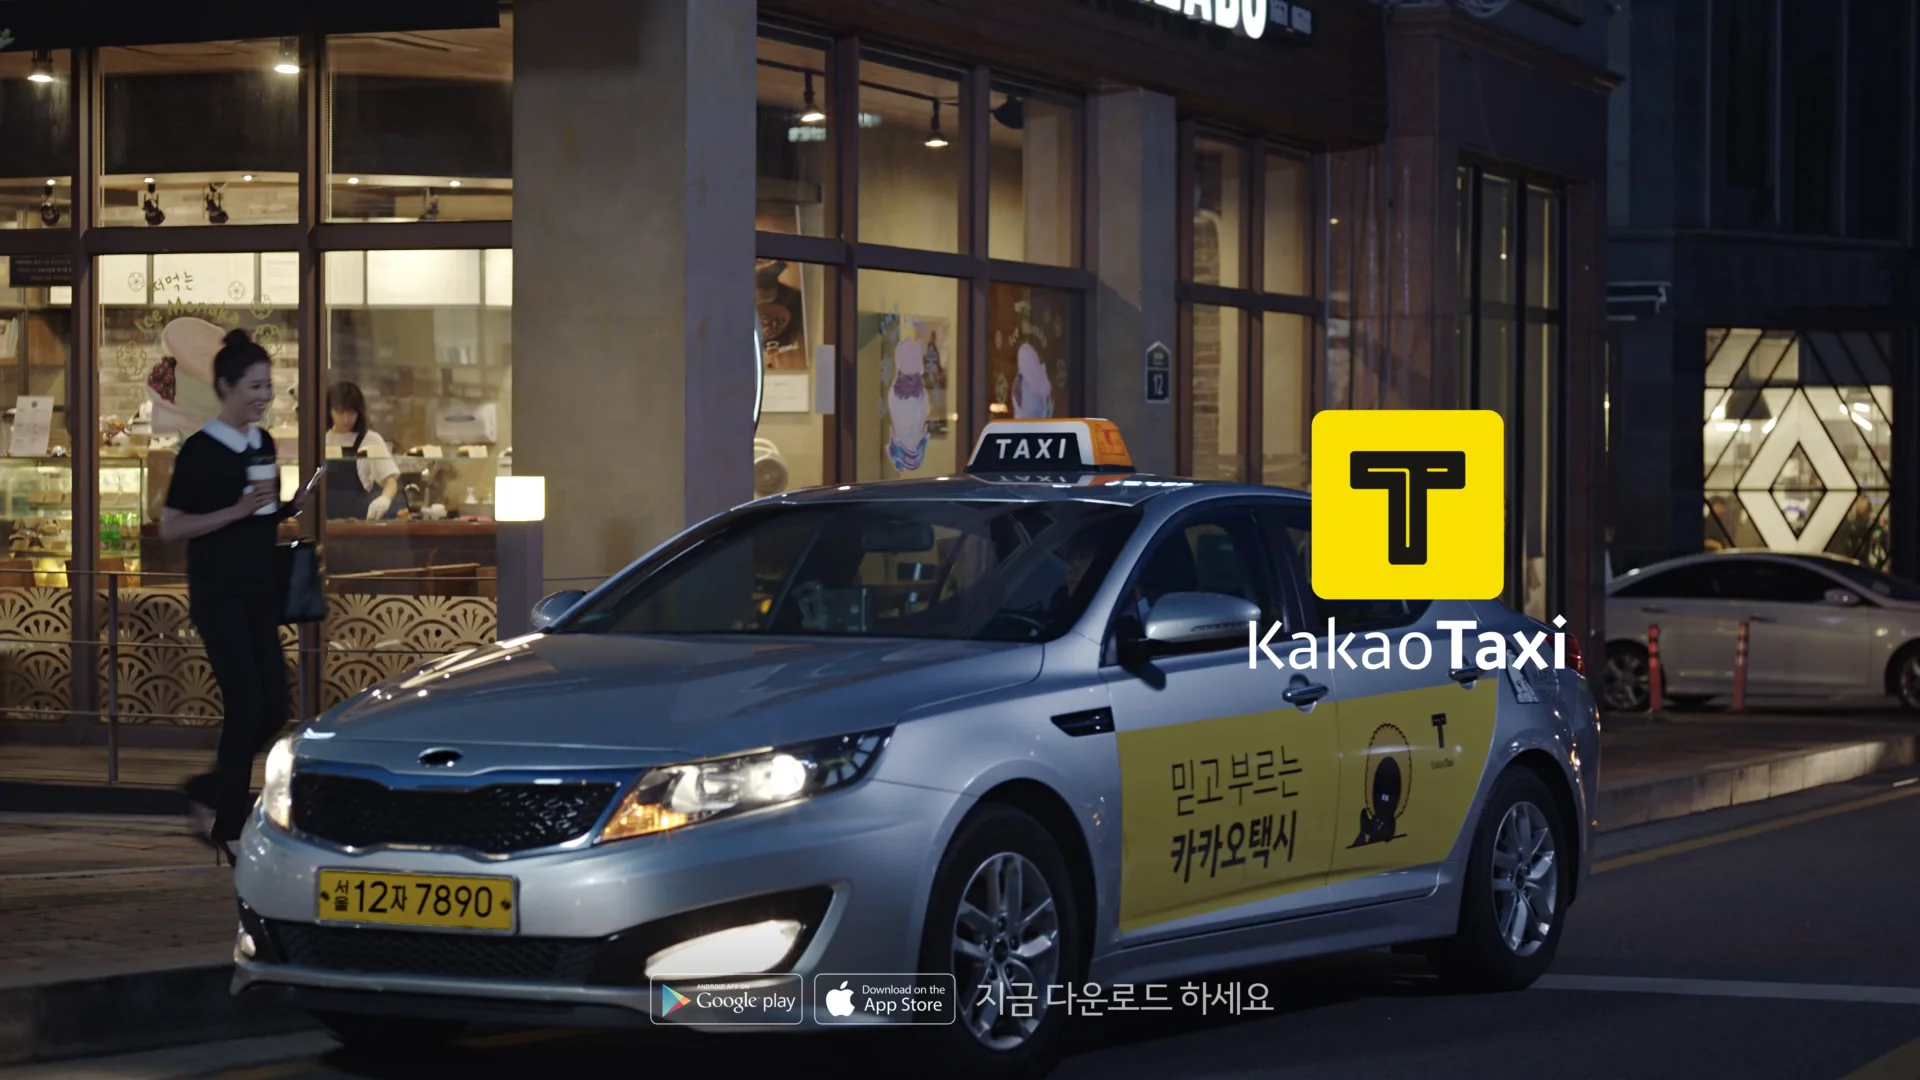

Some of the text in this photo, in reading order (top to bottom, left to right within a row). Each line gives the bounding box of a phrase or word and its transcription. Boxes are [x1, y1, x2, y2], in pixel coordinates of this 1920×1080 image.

[1153, 374, 1164, 396] 12
[995, 438, 1066, 459] TAXI
[1170, 809, 1298, 883] 카카오택시
[414, 883, 493, 918] 7890
